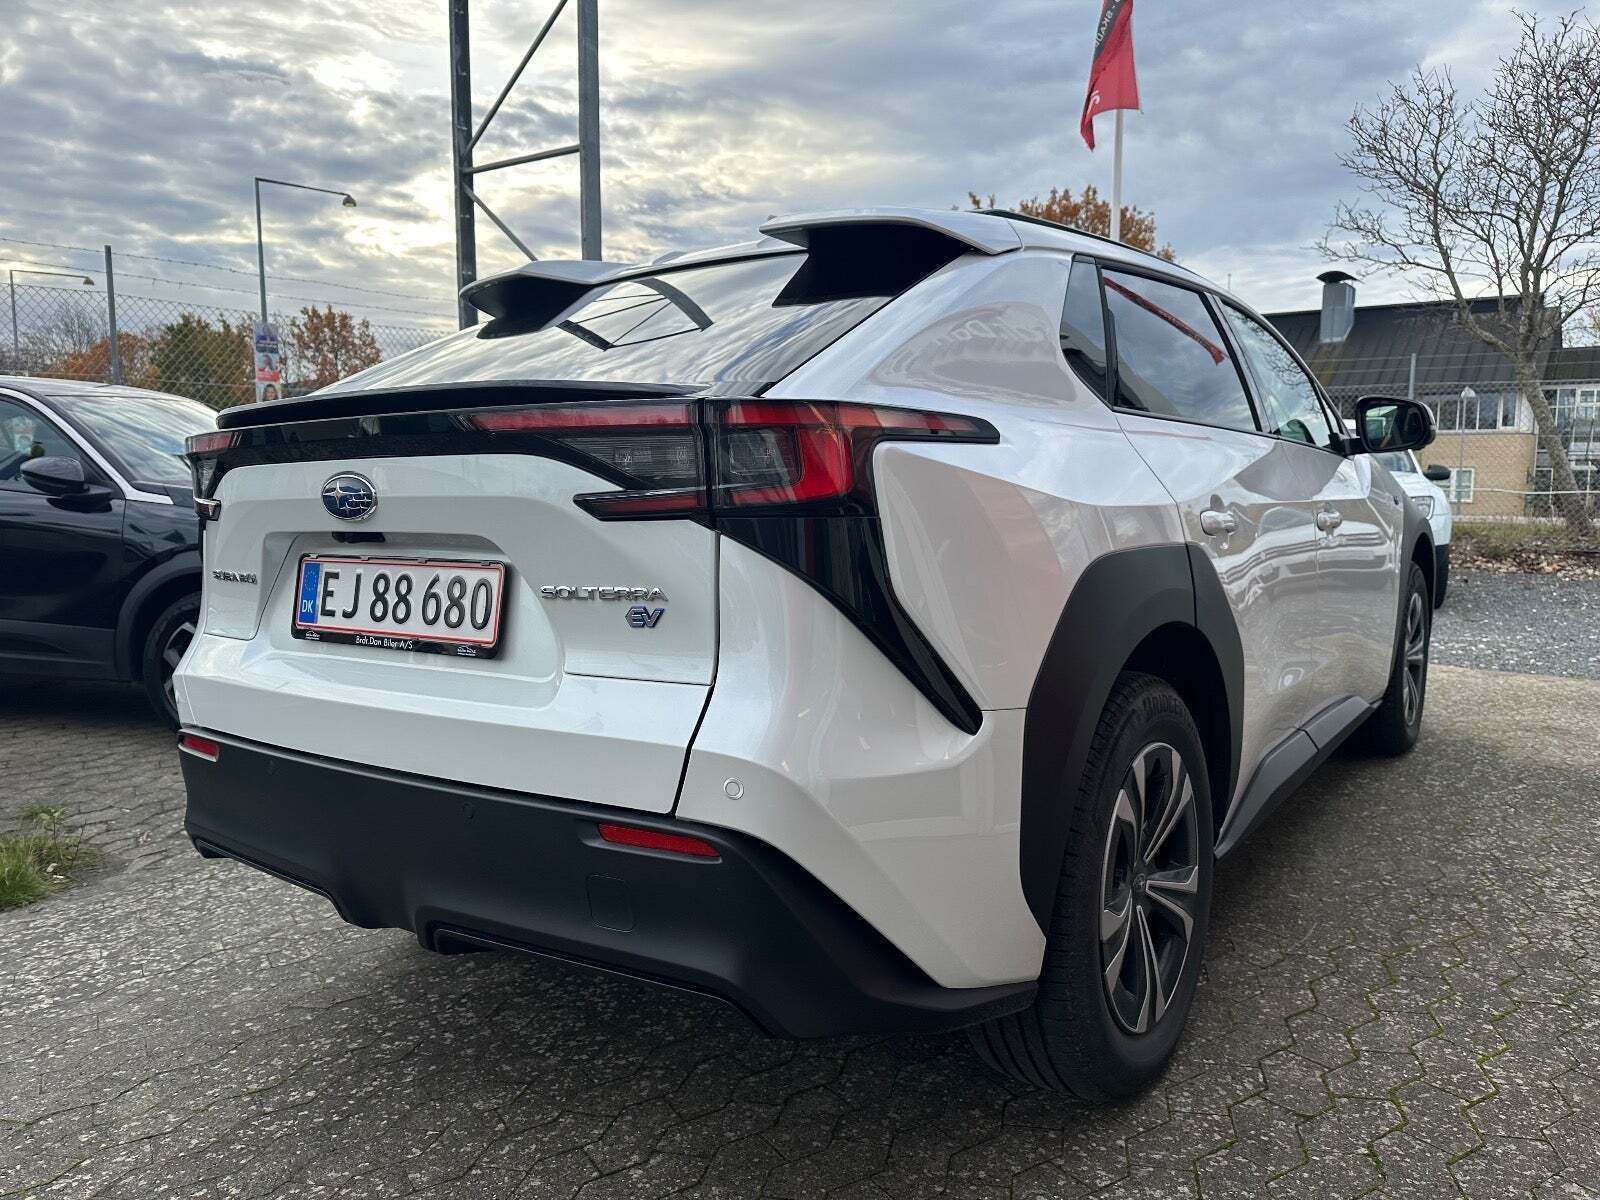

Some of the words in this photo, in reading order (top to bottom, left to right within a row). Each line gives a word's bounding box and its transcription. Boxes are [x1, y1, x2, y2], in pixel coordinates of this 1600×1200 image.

[320, 571, 362, 619] EJ
[369, 573, 413, 625] 88
[421, 573, 493, 631] 680
[540, 585, 668, 602] SOLTERRA
[301, 600, 313, 613] DK
[624, 605, 665, 628] EV
[399, 640, 413, 651] A/S
